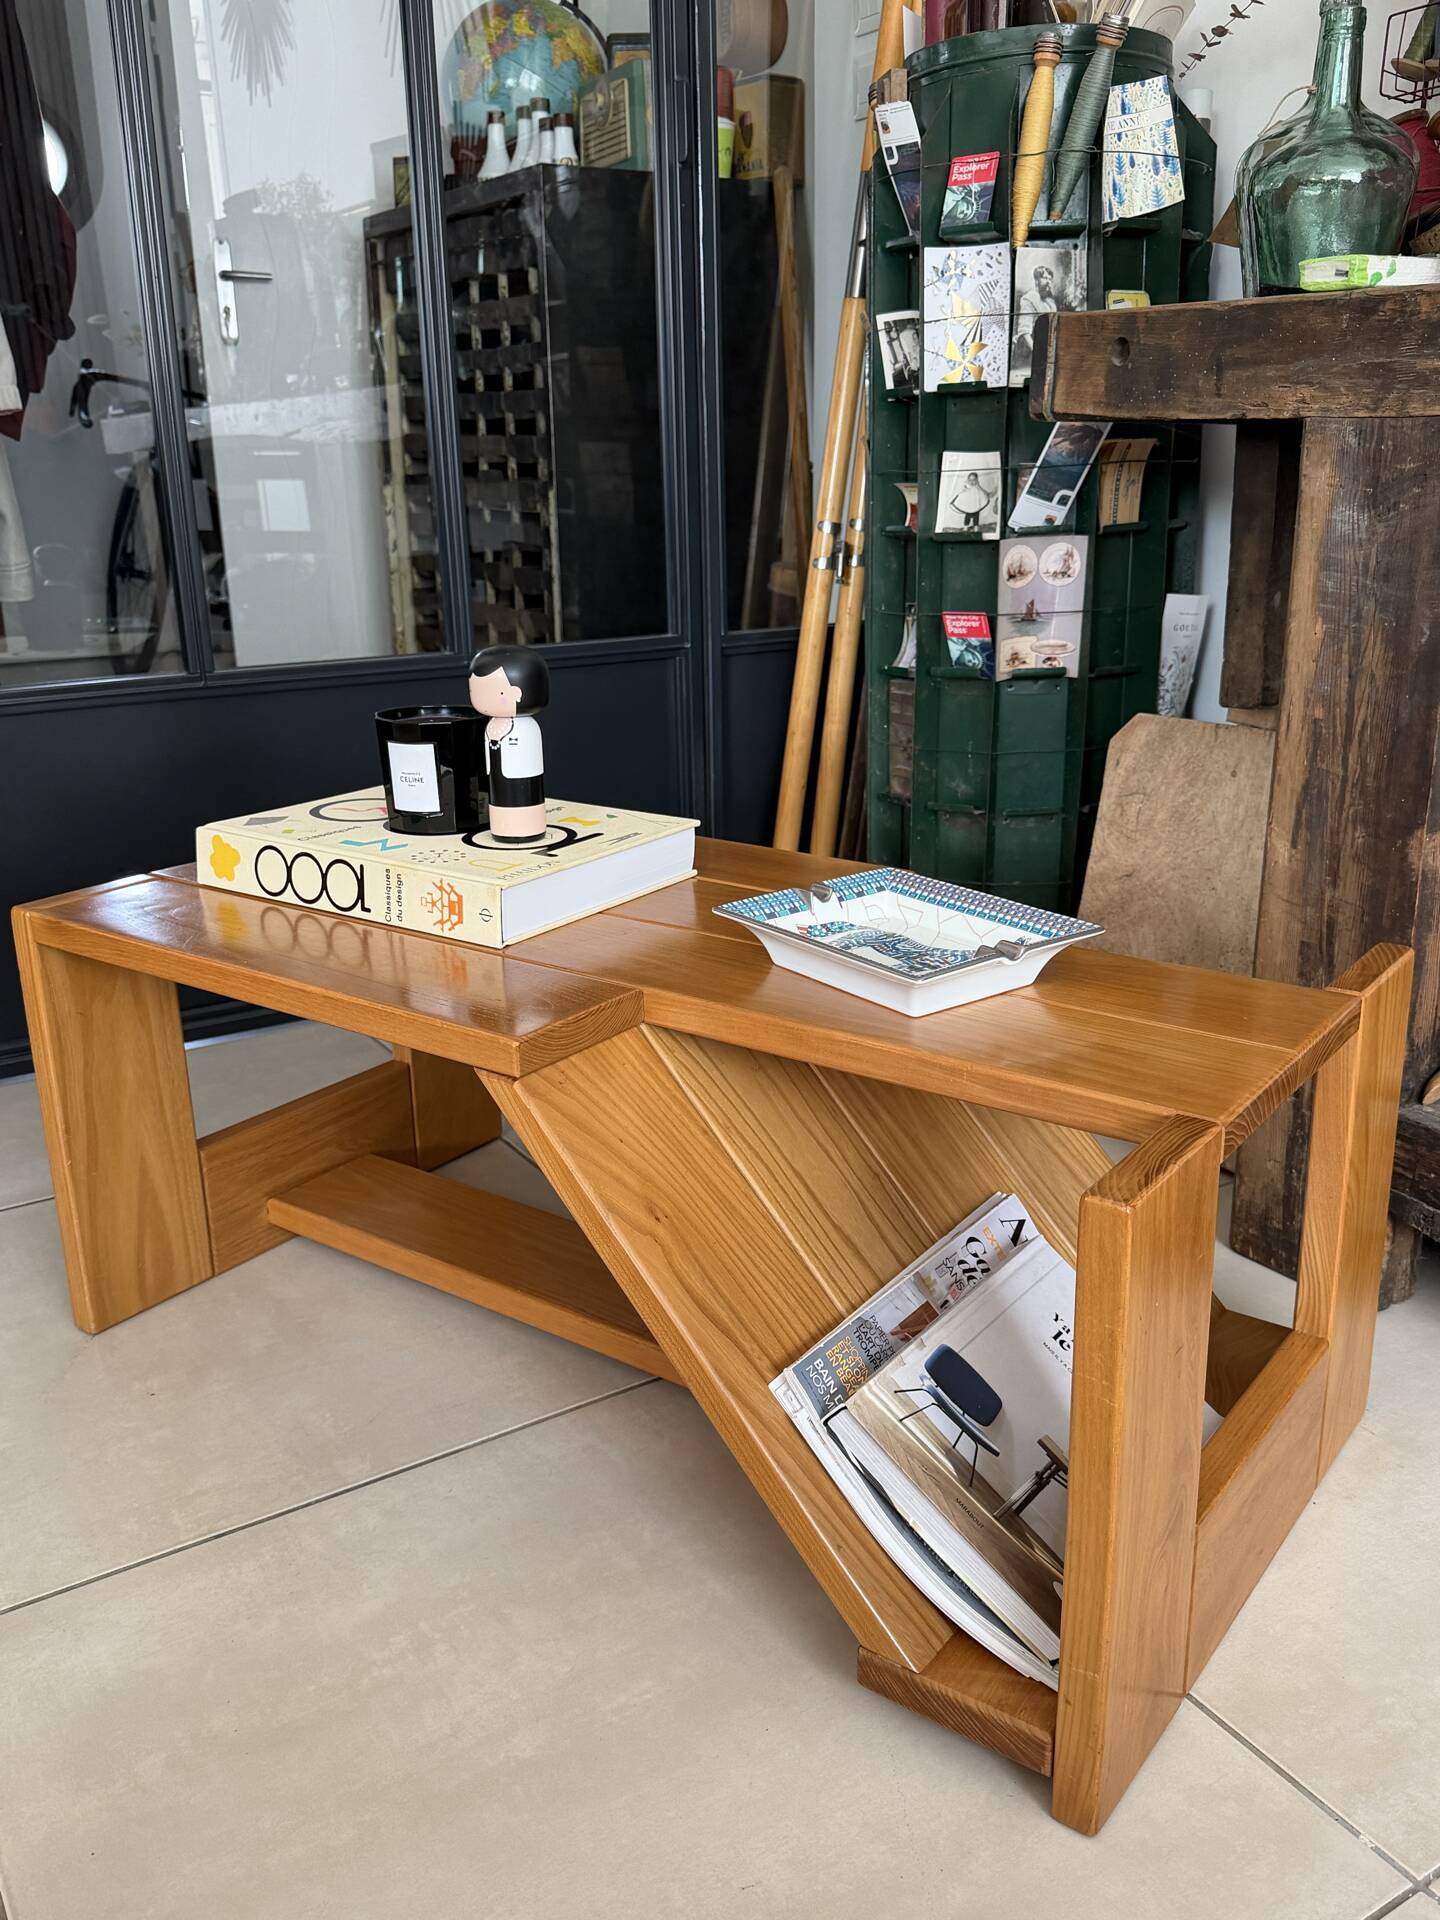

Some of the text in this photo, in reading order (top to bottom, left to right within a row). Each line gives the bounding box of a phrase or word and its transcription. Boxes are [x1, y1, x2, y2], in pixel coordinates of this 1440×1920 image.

[952, 172, 972, 181] Pass
[953, 162, 989, 173] Explorer
[946, 619, 980, 627] Explorer
[400, 775, 424, 783] CELINE
[255, 844, 372, 913] 1000
[396, 873, 404, 922] du design
[942, 1257, 965, 1290] SANS
[862, 1319, 877, 1336] OU
[869, 1315, 890, 1346] PAPIER
[824, 1349, 838, 1367] EN
[836, 1340, 849, 1354] ET
[846, 1357, 855, 1367] SI
[852, 1327, 880, 1371] TROMPE
[805, 1364, 827, 1395] NOS
[814, 1358, 838, 1393] BAIN
[954, 1497, 984, 1529] MARABOUT
